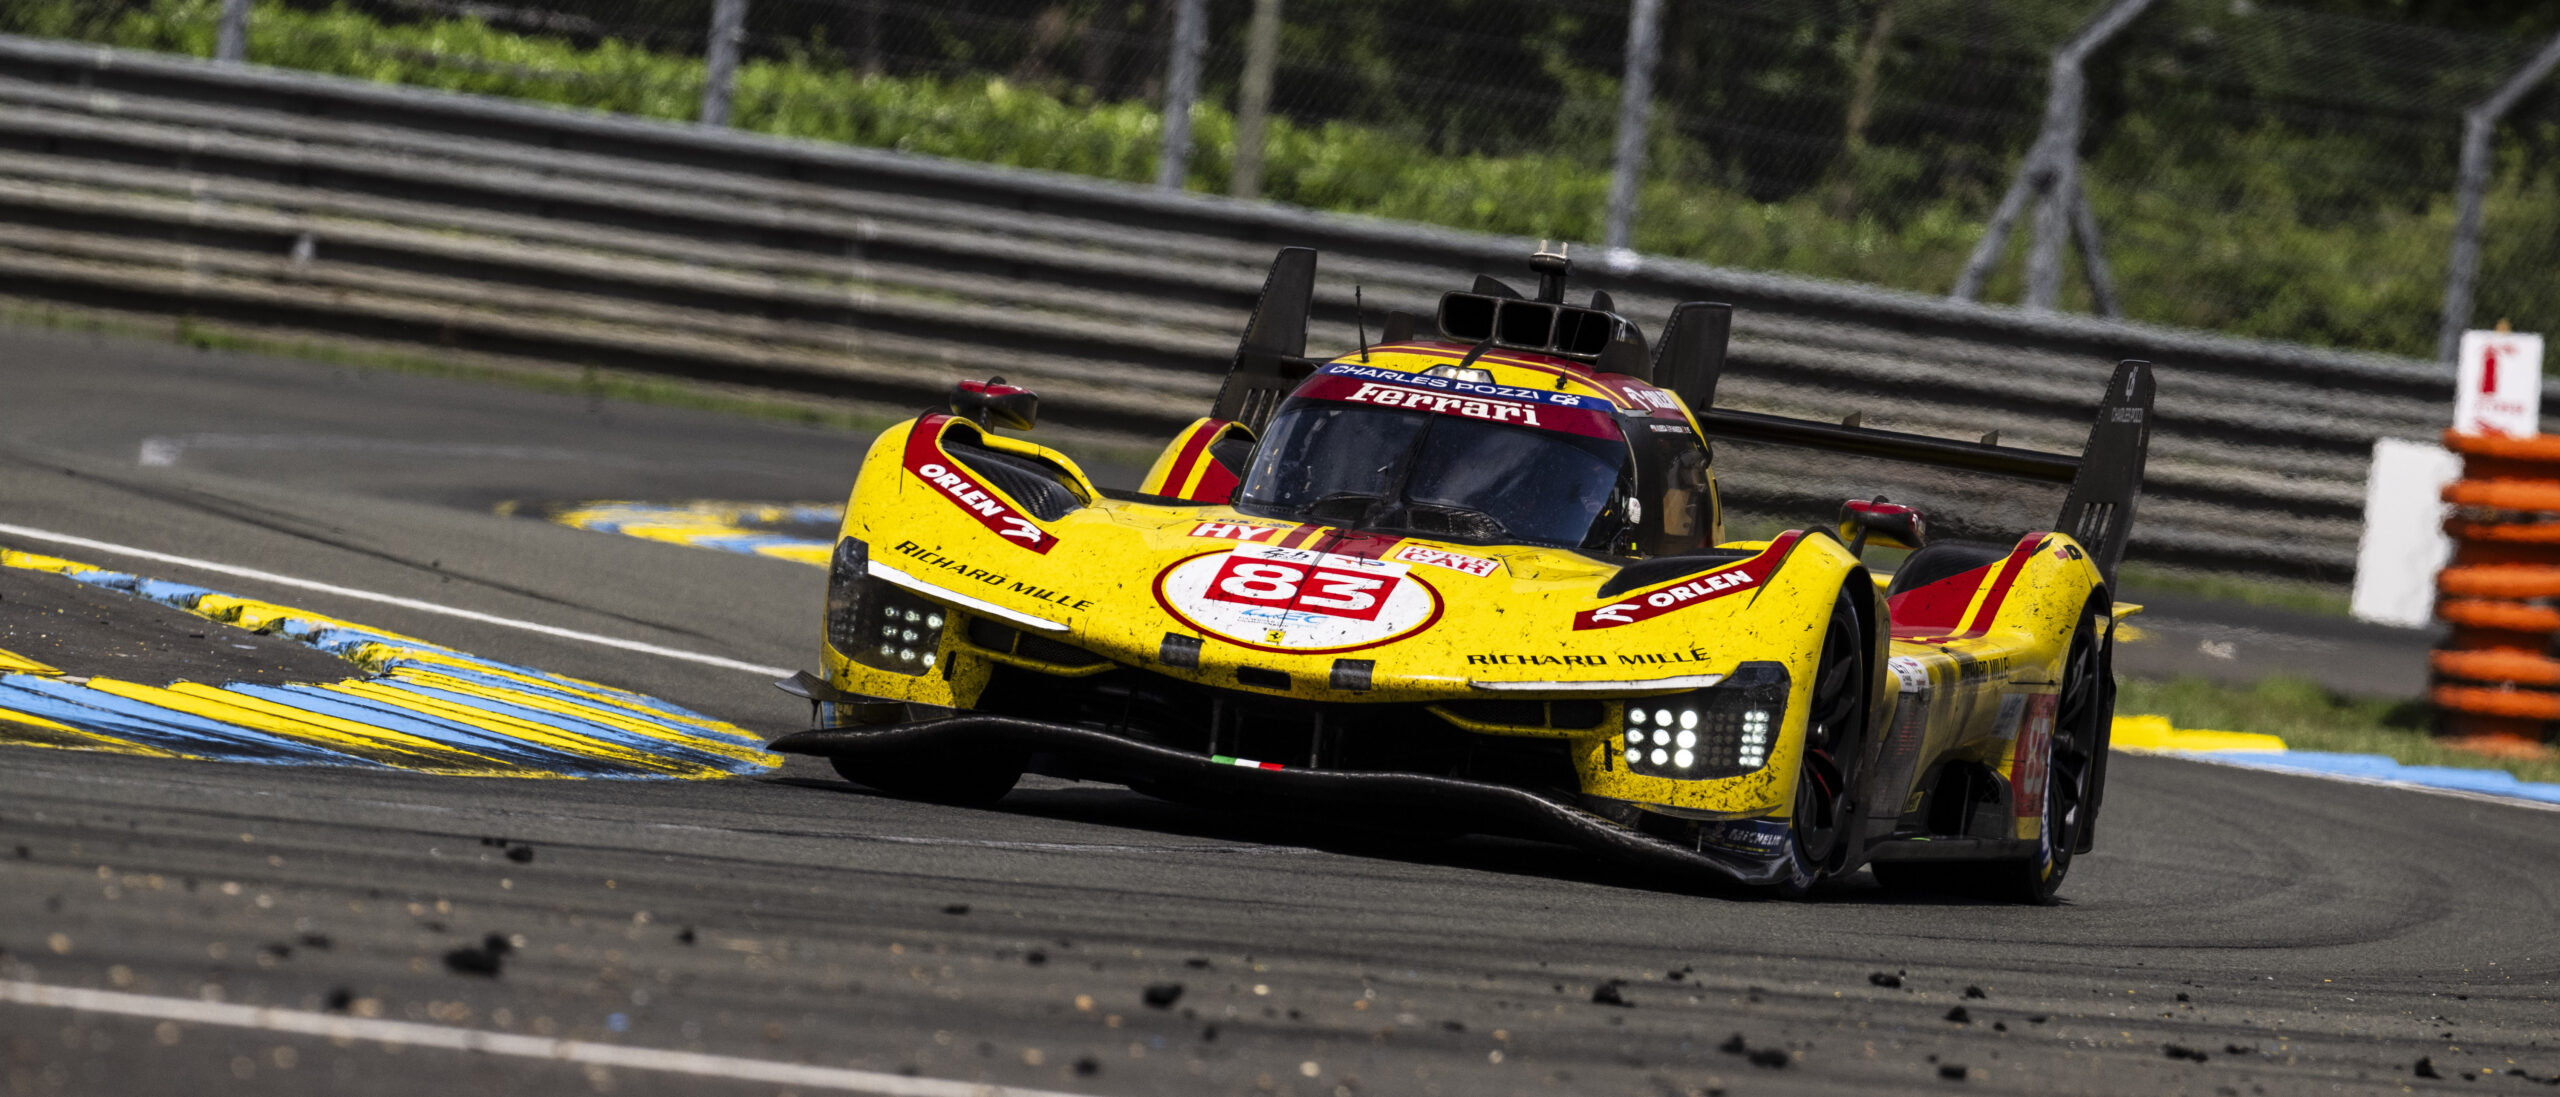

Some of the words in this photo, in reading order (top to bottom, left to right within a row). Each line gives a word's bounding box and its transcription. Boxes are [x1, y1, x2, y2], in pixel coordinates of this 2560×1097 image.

[1330, 365, 1449, 389] CHARLES
[1454, 379, 1539, 400] POZZI
[1345, 382, 1541, 427] Ferrari
[919, 464, 1005, 517] ORLEN
[1191, 523, 1277, 540] HY
[1403, 552, 1485, 574] CAR
[1409, 548, 1491, 567] HYPER
[894, 540, 1006, 586] RICHARD
[1007, 582, 1095, 612] MILLE
[1220, 563, 1384, 611] 83
[1648, 570, 1754, 607] ORLEN
[1466, 653, 1608, 666] RICHARD
[1618, 648, 1712, 666] MILLE
[1727, 828, 1782, 846] MICHELIN
